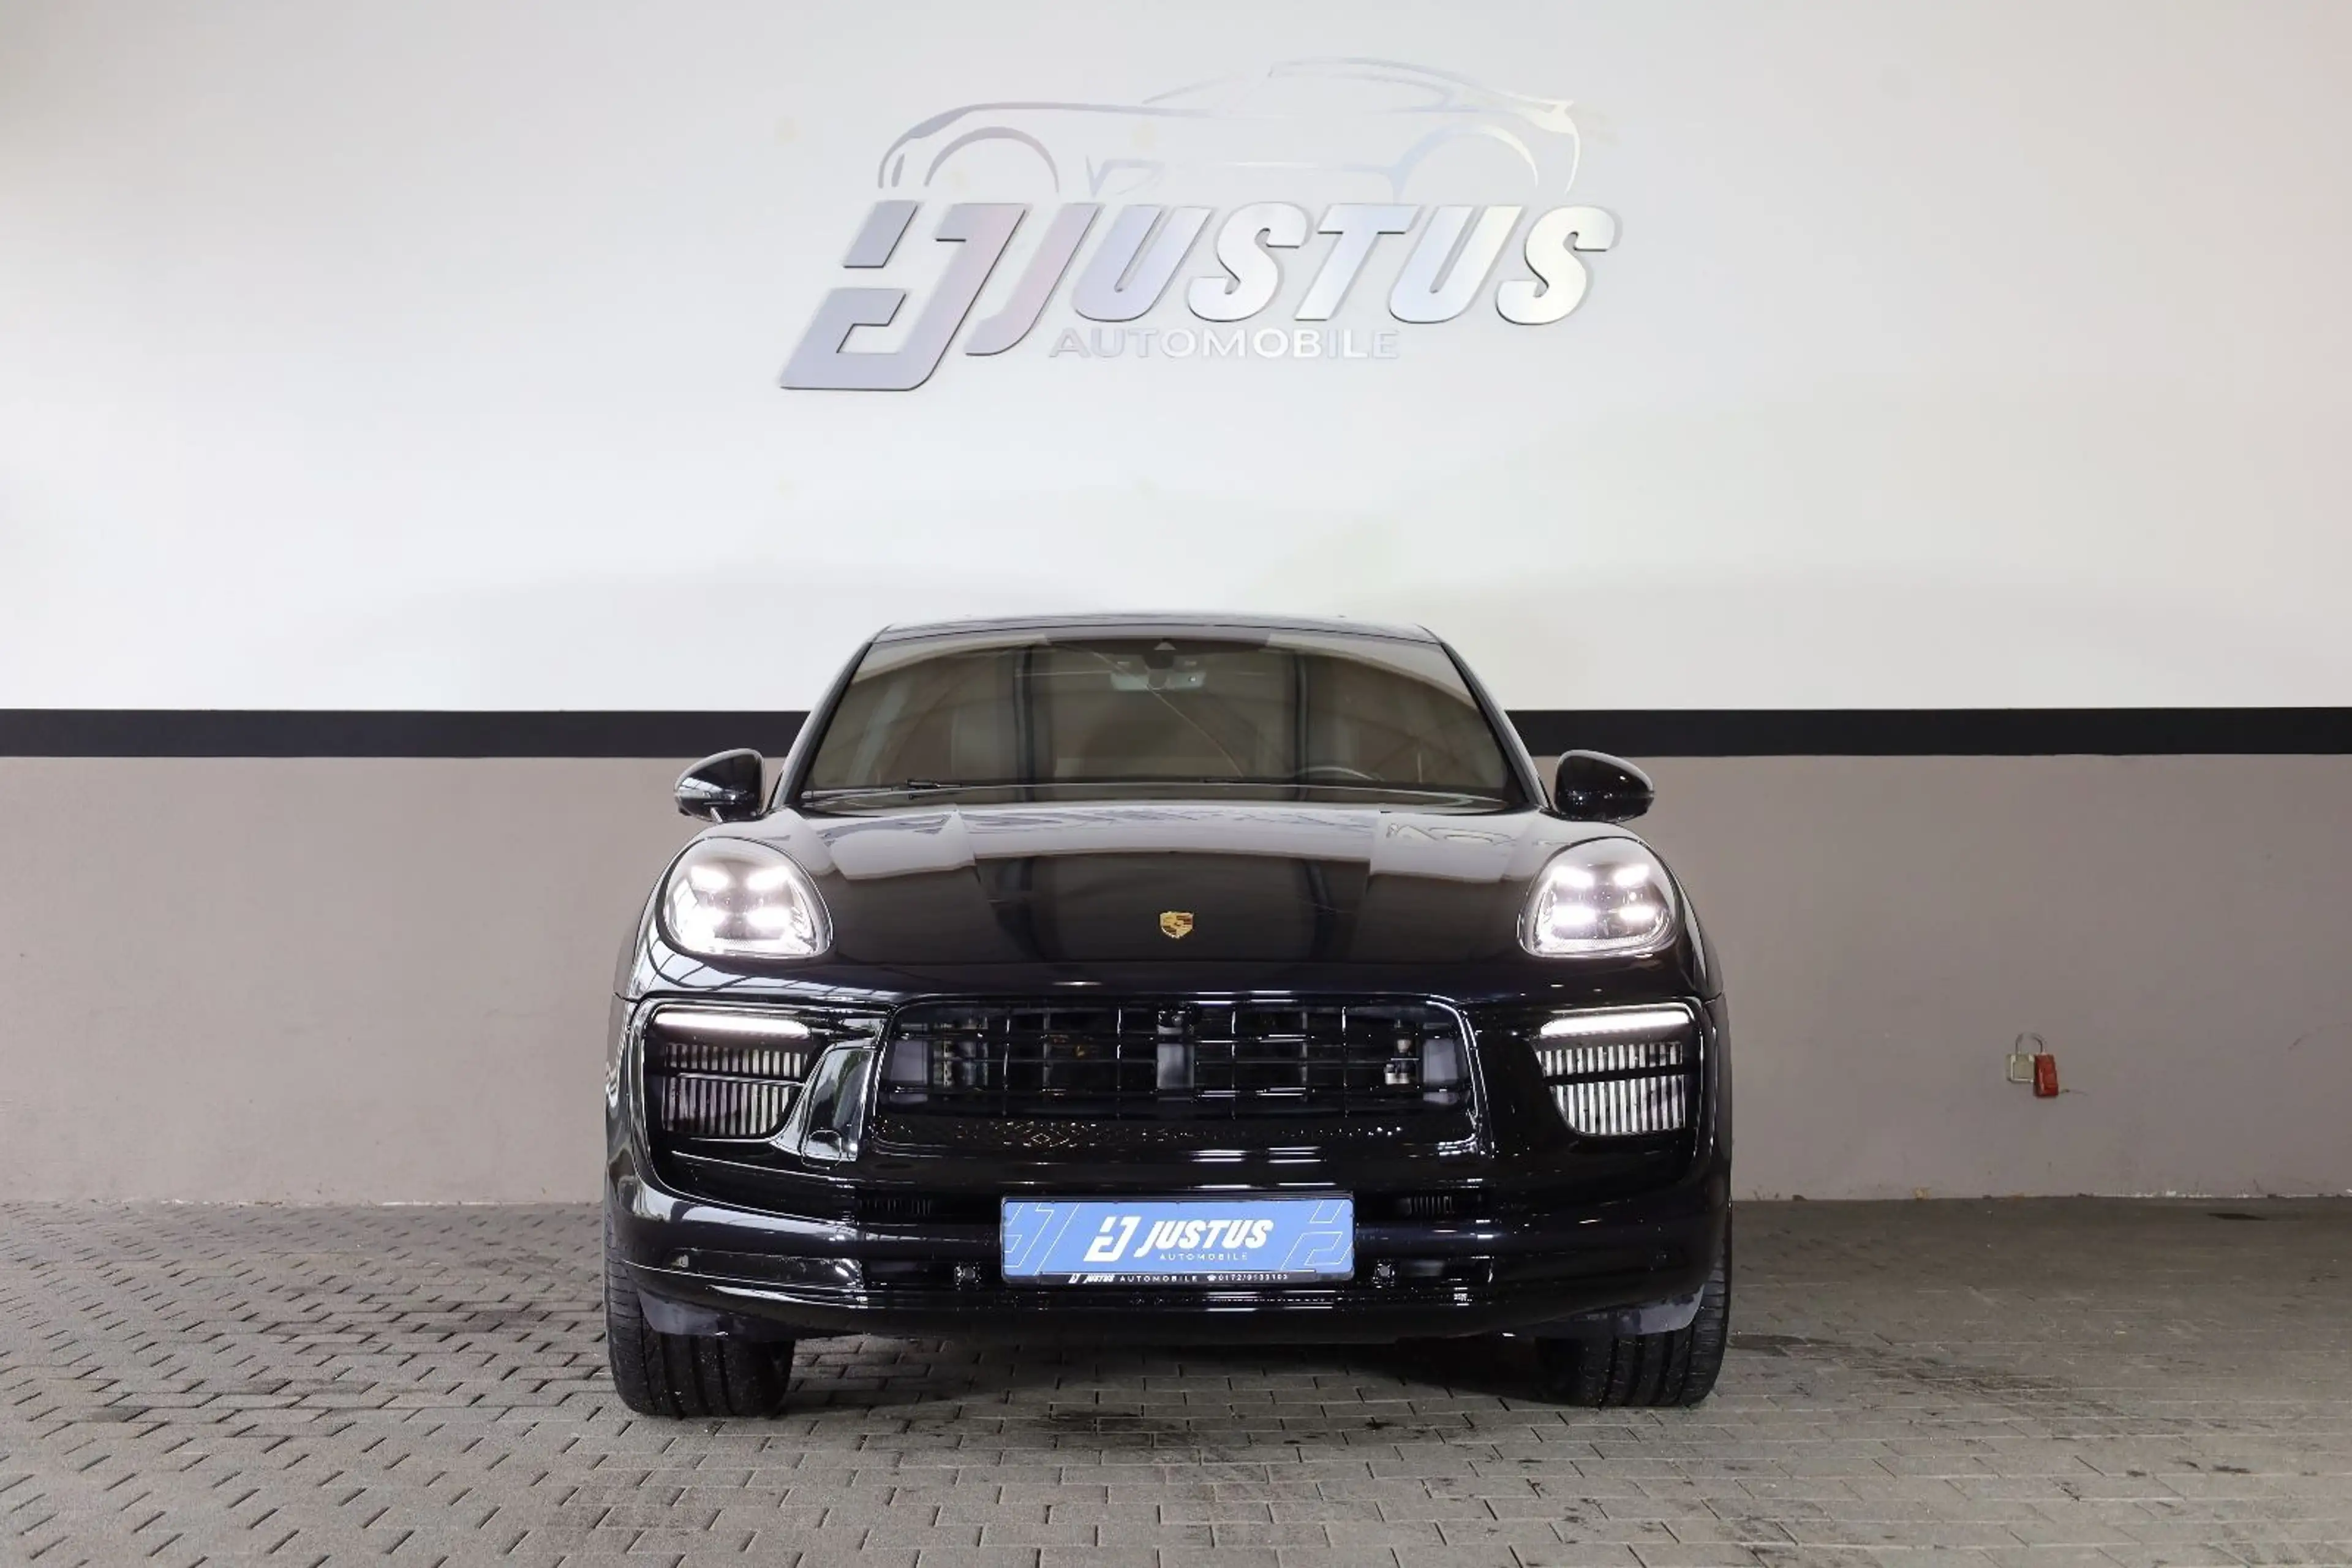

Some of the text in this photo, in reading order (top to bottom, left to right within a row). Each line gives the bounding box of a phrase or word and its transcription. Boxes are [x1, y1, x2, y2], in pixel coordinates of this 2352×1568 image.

[967, 202, 1617, 356] JUSTUS
[1049, 327, 1400, 359] AUTOMOBILE
[1134, 1219, 1274, 1257] JUSTUS
